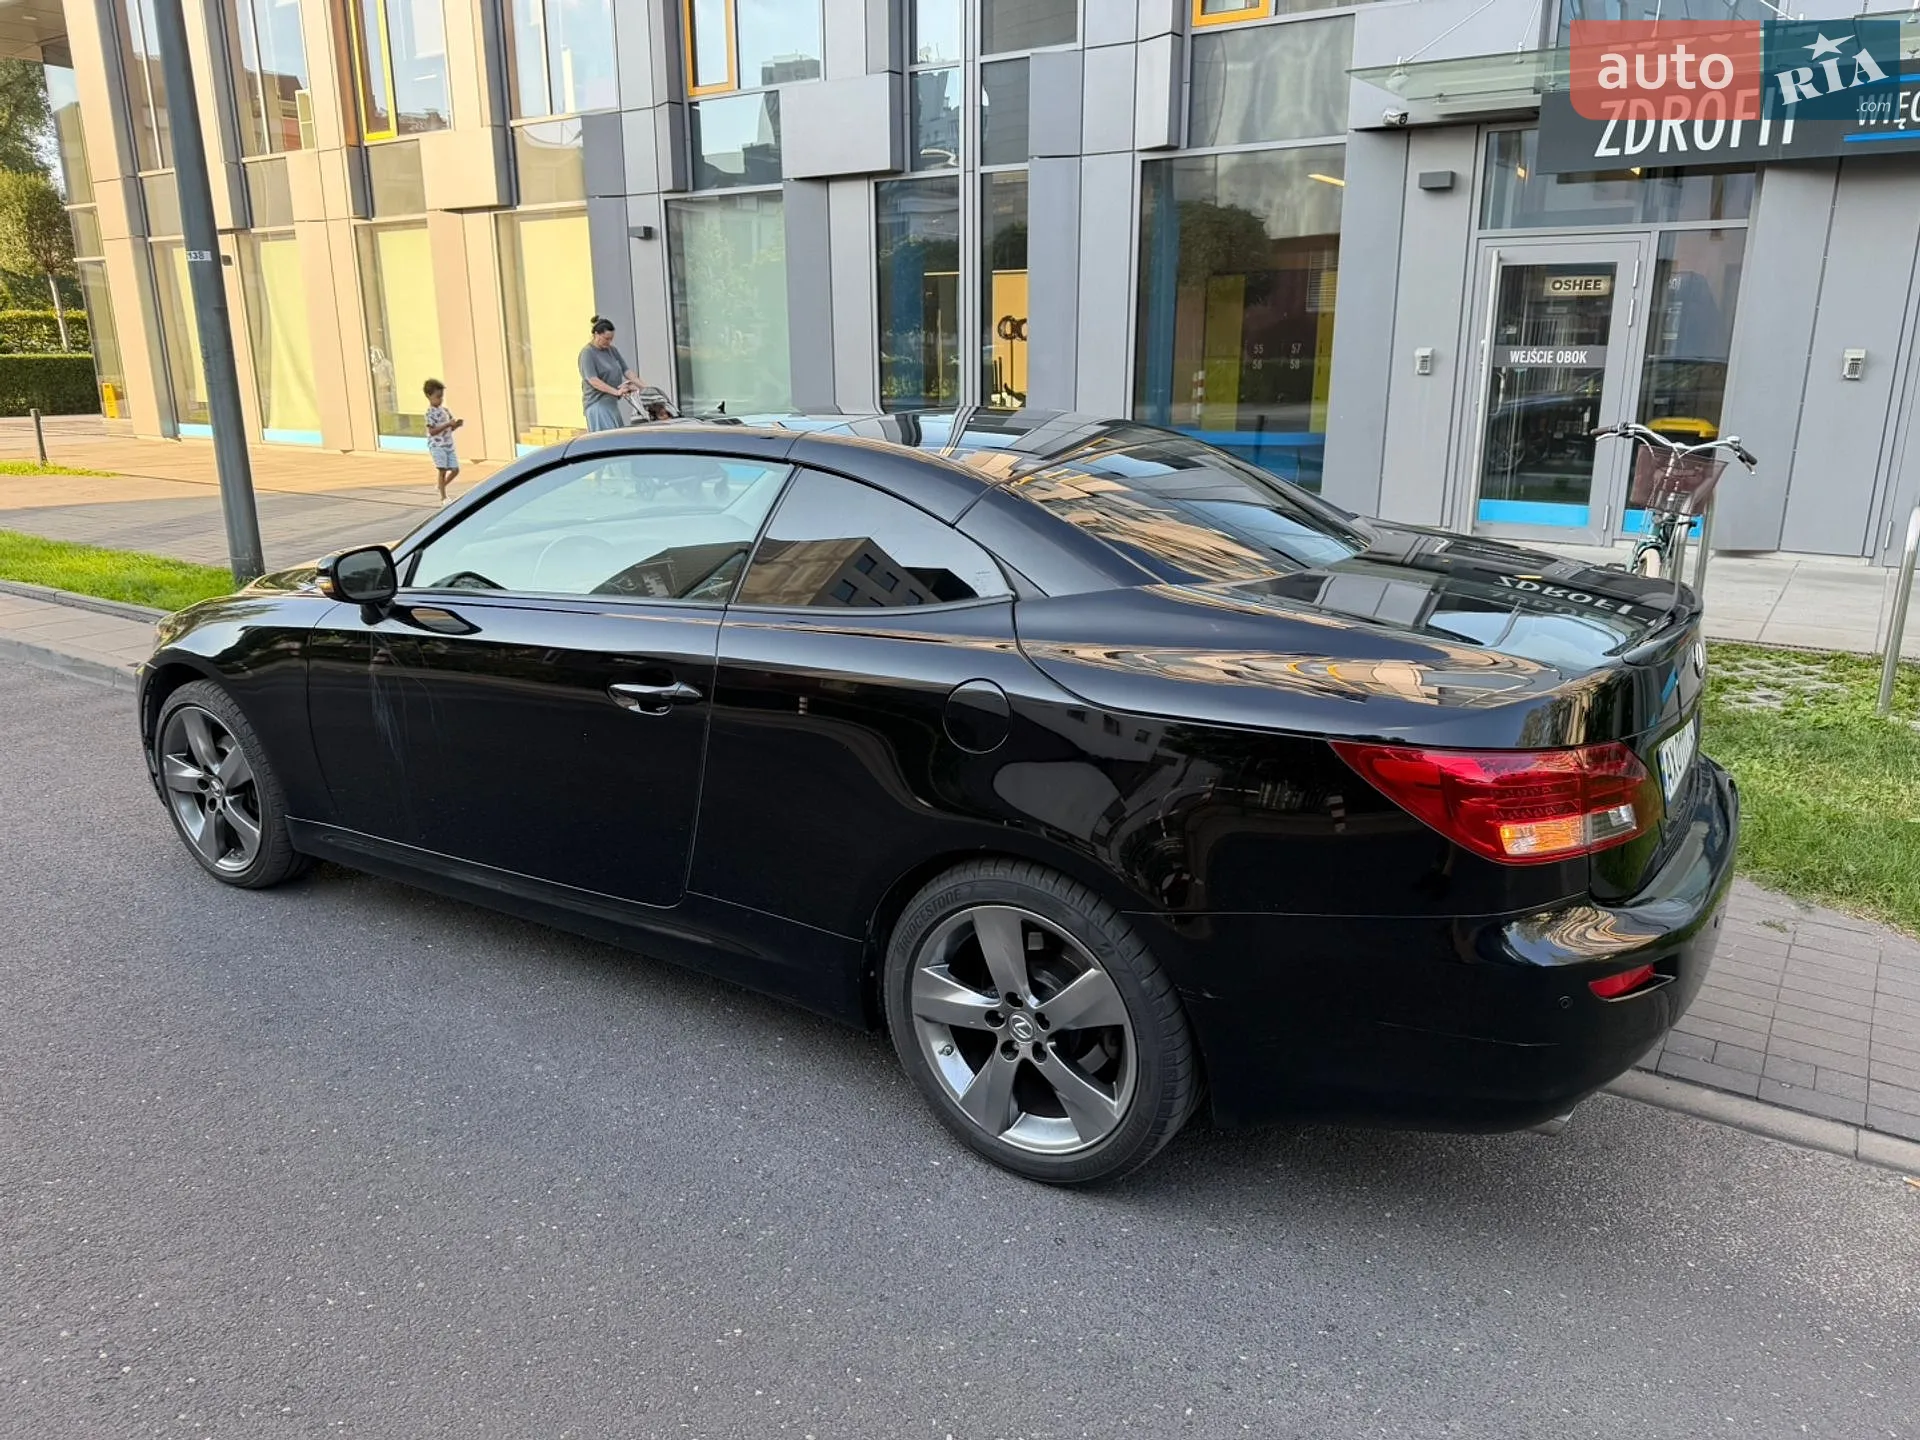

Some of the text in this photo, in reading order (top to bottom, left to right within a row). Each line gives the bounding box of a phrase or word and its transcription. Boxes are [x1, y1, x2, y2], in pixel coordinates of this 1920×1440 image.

[1551, 279, 1602, 291] OSHEE
[1510, 348, 1588, 364] WEJŚCIE OBOK
